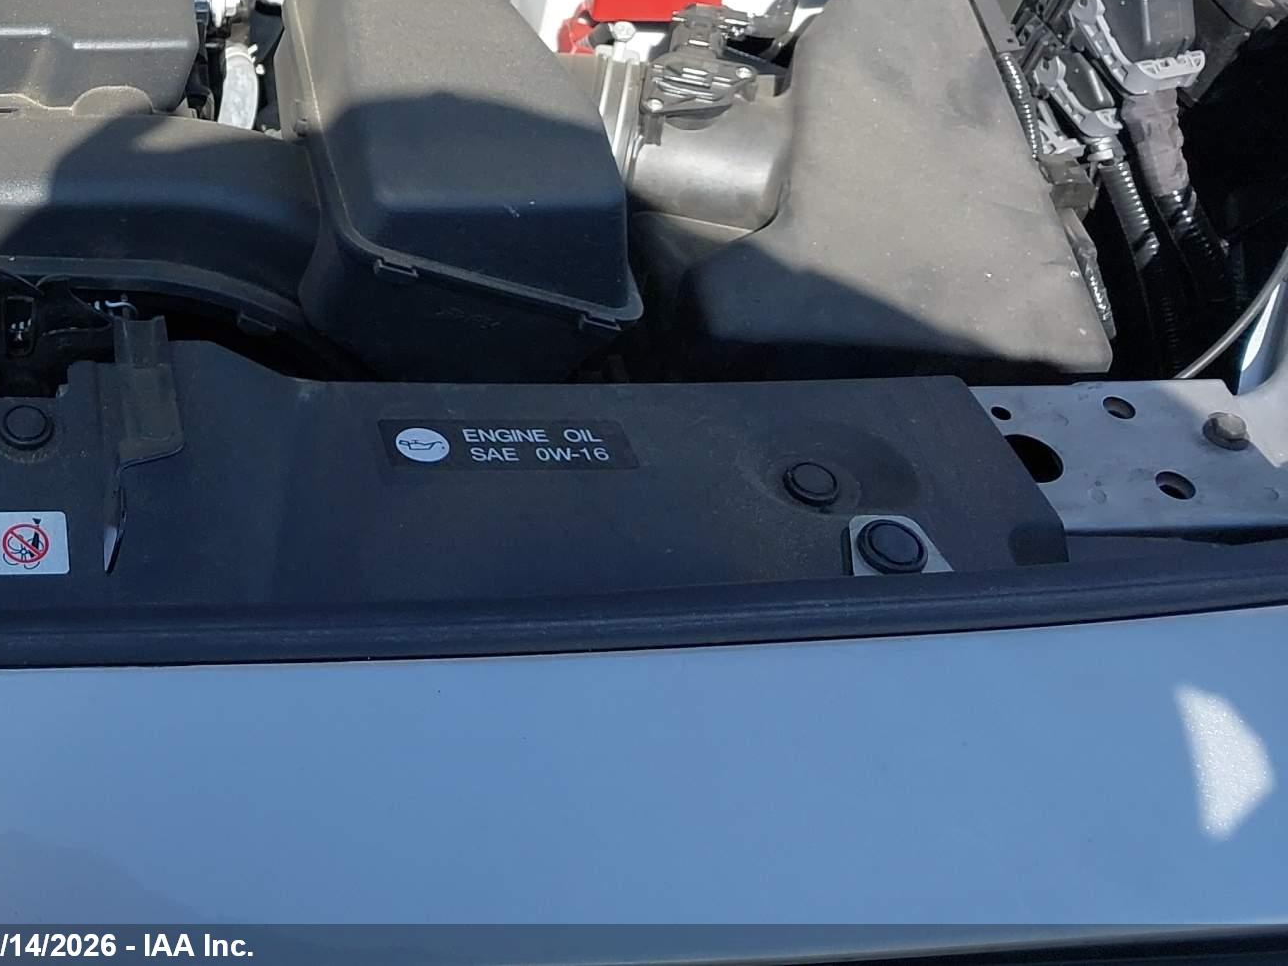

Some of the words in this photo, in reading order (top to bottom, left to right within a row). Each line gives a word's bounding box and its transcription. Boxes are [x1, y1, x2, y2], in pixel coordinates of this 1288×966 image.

[462, 428, 549, 443] ENGINE
[563, 428, 603, 443] OIL
[470, 447, 520, 462] SAE
[535, 447, 610, 462] 0W-16
